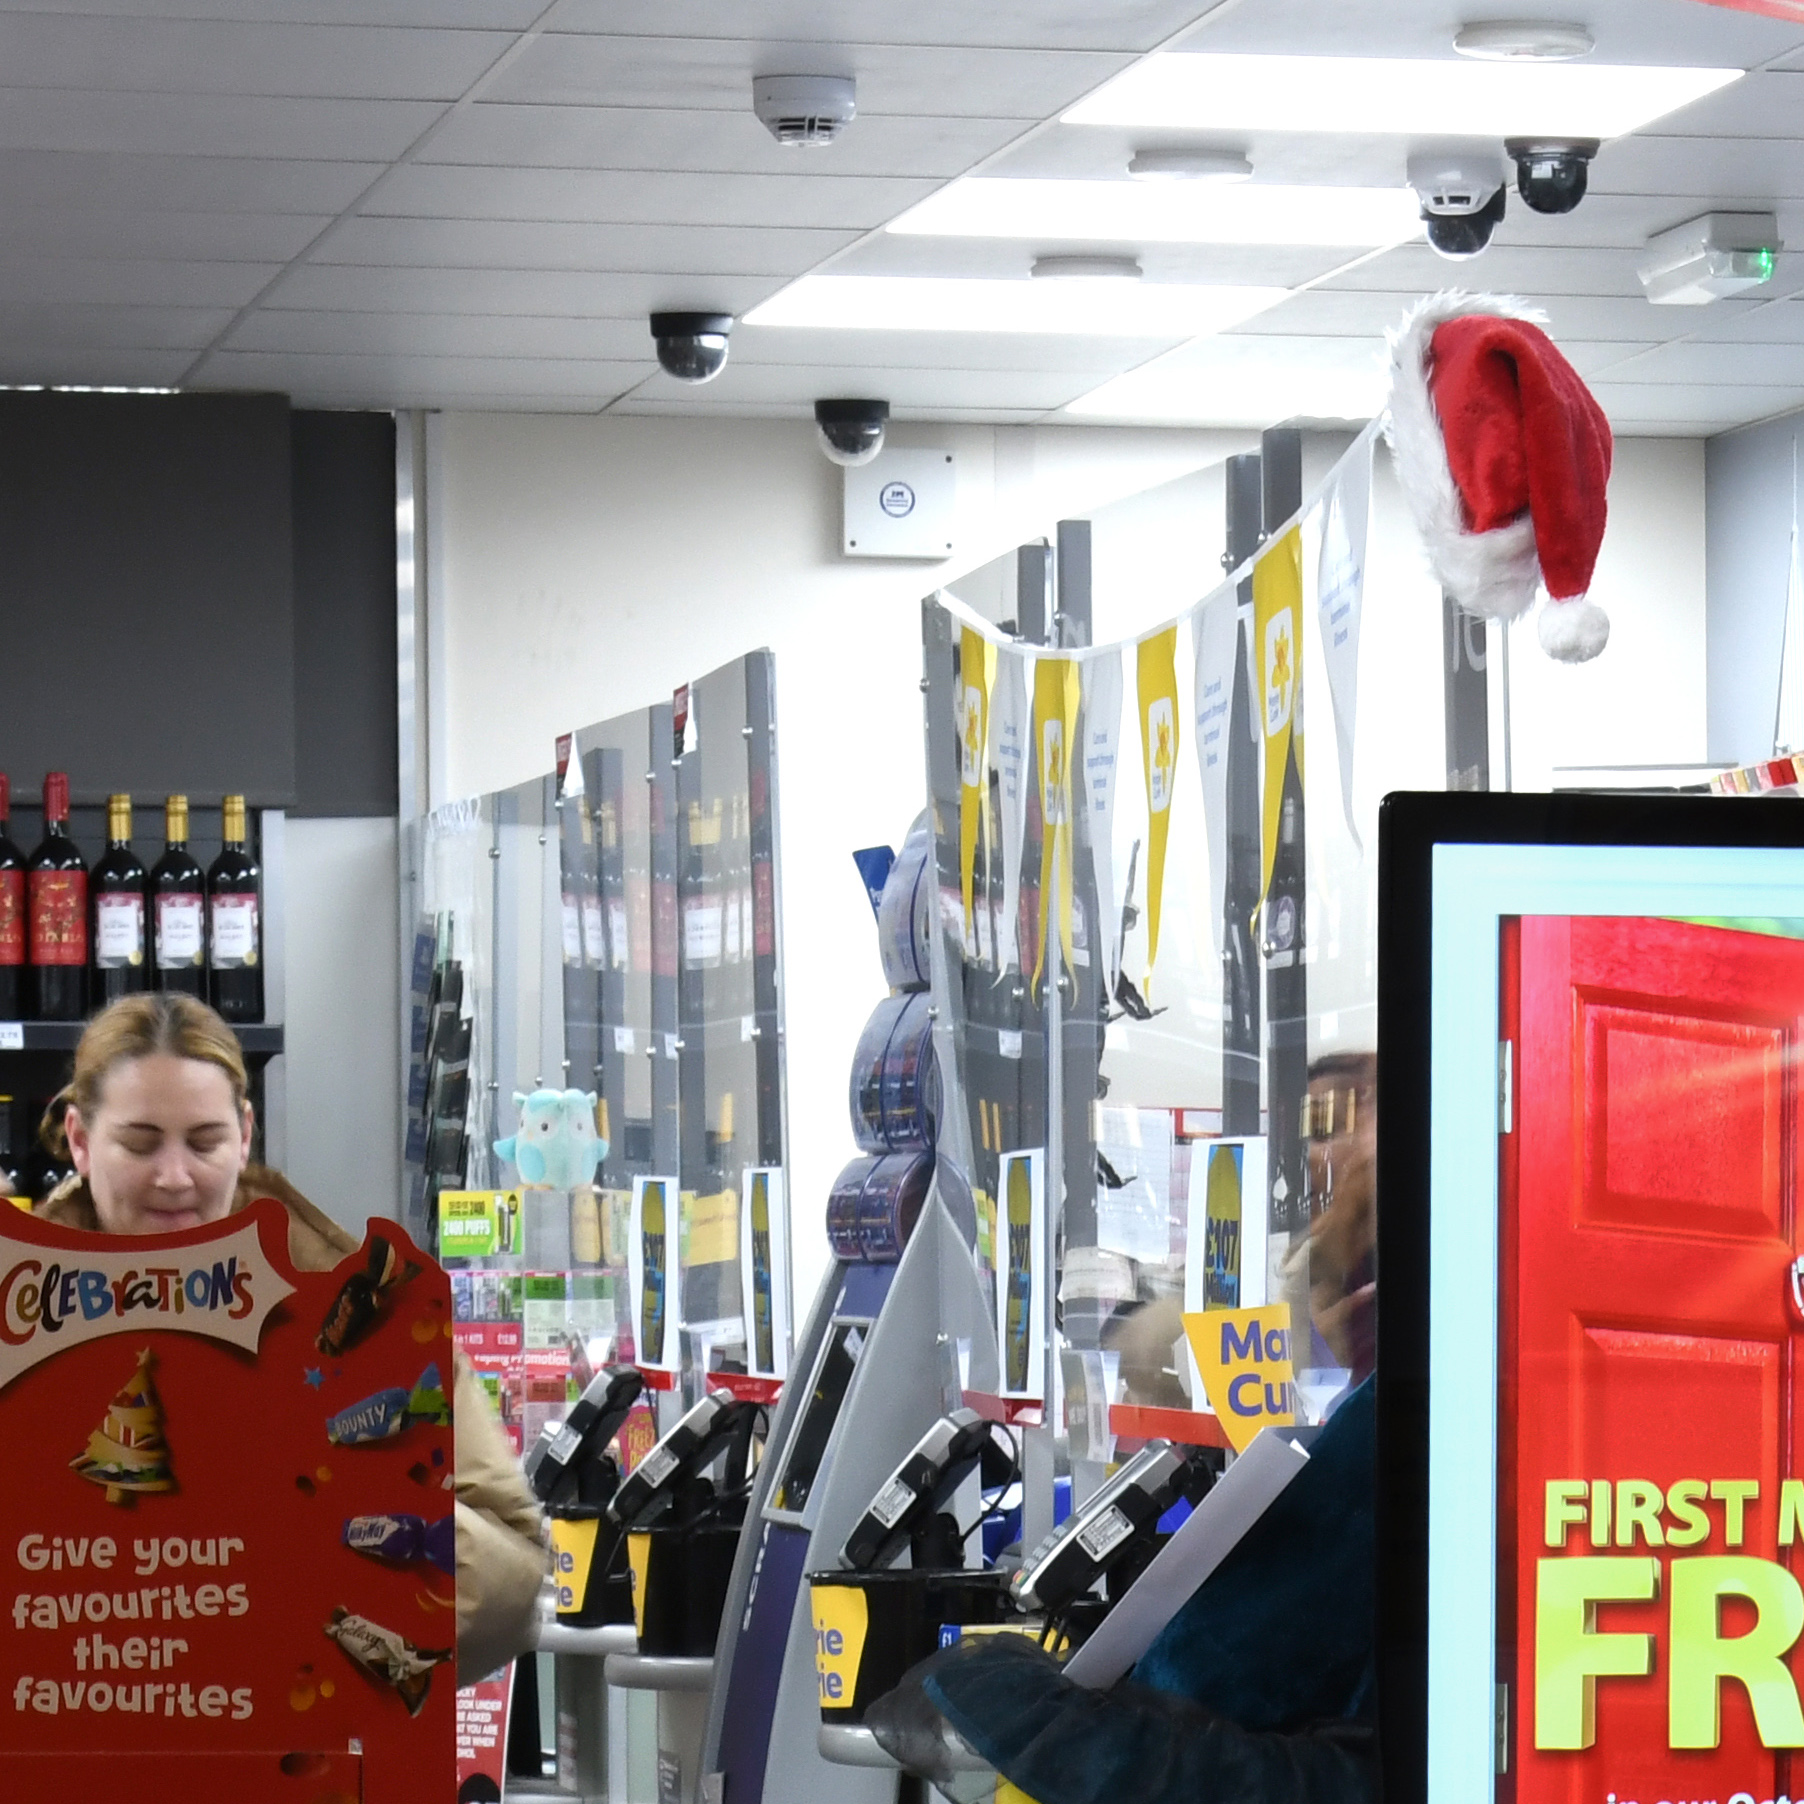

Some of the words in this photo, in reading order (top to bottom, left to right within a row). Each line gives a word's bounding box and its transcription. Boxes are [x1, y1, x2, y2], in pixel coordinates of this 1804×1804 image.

[465, 1219, 491, 1235] PUFFS
[334, 1404, 386, 1439] BOUNTY
[1544, 1478, 1759, 1547] FIRST
[17, 1534, 117, 1571] Give
[134, 1534, 245, 1575] your
[12, 1580, 250, 1630] favourites
[74, 1634, 189, 1672] their
[13, 1677, 254, 1721] favourites
